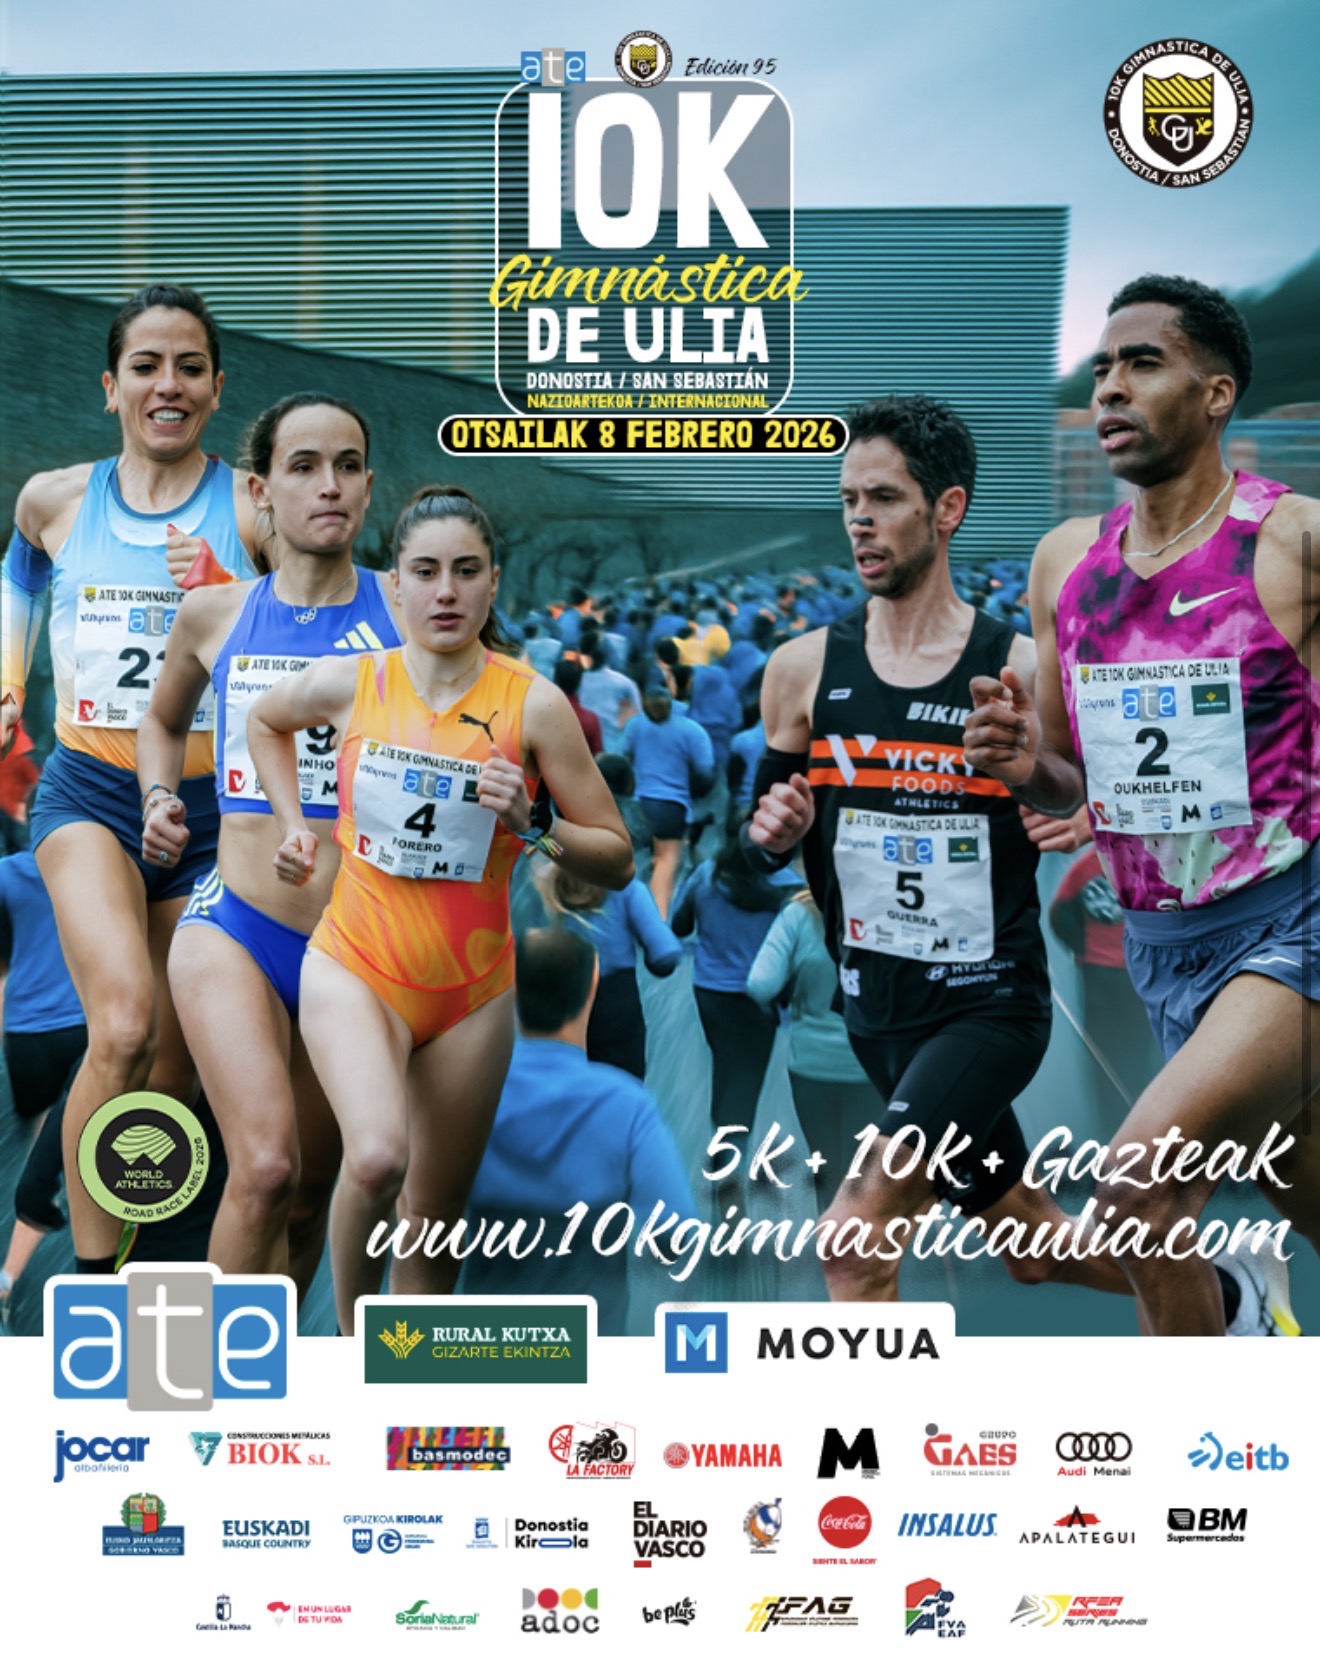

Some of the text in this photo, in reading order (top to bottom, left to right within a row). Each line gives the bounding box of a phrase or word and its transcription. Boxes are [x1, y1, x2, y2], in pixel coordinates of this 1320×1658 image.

[522, 51, 584, 83] ate
[685, 57, 777, 76] Edición 95
[1108, 40, 1249, 105] 10K GIMNASTICA DE ULIA
[1109, 128, 1158, 183] DONOSTIA
[1172, 172, 1201, 186] SAN
[1202, 119, 1251, 179] SEBASTIAN
[528, 92, 776, 250] 10K
[489, 253, 810, 312] Gimnástica
[528, 307, 770, 363] DE ULIA
[526, 372, 613, 389] DONOSTIA
[632, 372, 667, 389] SAN
[674, 366, 769, 389] SEBASTIÁN
[527, 393, 633, 408] NAZIOARTEKOA
[649, 393, 769, 408] INTERNACIONAL
[451, 420, 836, 448] OTSAILAK 8 FEBRERO 2026
[99, 589, 117, 601] ATE
[118, 589, 134, 601] 10K
[116, 647, 165, 689] 2
[252, 659, 269, 671] ATE
[272, 659, 287, 672] 10K
[1092, 662, 1230, 682] ATE 10K GIMNASTICA DE ULIA
[1124, 687, 1175, 719] ate
[379, 746, 478, 775] ATE 10K GIMNASTICA DE
[1135, 727, 1171, 777] 2
[884, 749, 975, 778] VICKY
[404, 771, 450, 798] ate
[892, 776, 965, 796] FOODS
[1114, 780, 1202, 795] OUKHELFEN
[894, 798, 960, 809] ATHLETICS
[404, 803, 436, 839] 4
[856, 814, 980, 831] ATE 10K GIMNASTICA DE ULIA
[392, 836, 442, 853] FORERO
[884, 837, 932, 866] ate
[896, 871, 925, 911] 5
[887, 910, 938, 927] GUERRA
[1022, 1120, 1295, 1191] Gazteak
[115, 1180, 172, 1189] ATHLETICS
[123, 1136, 205, 1218] ROAD RACE LABEL 2026
[124, 1170, 164, 1179] WORLD
[60, 1284, 280, 1399] ate
[432, 1327, 571, 1342] RURAL KUTXA
[757, 1326, 940, 1360] MOYUA
[432, 1346, 571, 1358] GIZARTE EKINTZA
[227, 1431, 331, 1440] CONSTRUCCIONES METÁLICAS
[979, 1431, 1017, 1439] GRUPO
[54, 1430, 150, 1483] jocar
[227, 1442, 302, 1465] BIOK
[412, 1448, 508, 1462] basmodec
[691, 1444, 782, 1467] YAMAHA
[924, 1433, 1017, 1466] GAES
[1226, 1443, 1290, 1471] eitb
[566, 1464, 635, 1476] LA FACTORY
[1057, 1466, 1132, 1476] Audi Menai
[343, 1514, 444, 1524] GIPUZKOA KIROLAK
[633, 1501, 658, 1518] EL
[1199, 1508, 1248, 1531] BM
[222, 1520, 310, 1536] EUSKADI
[515, 1518, 589, 1532] Donostia
[633, 1520, 708, 1538] DIARIO
[898, 1513, 997, 1537] INSALUS
[222, 1539, 311, 1549] BASQUE COUNTRY
[1019, 1532, 1135, 1544] APALATEGUI
[1167, 1533, 1245, 1543] Supermercados
[633, 1540, 706, 1558] VASCO
[298, 1605, 352, 1613] EN UN LUGAR
[642, 1601, 696, 1624] be plus
[298, 1616, 343, 1624] DE TU VIDA
[521, 1610, 600, 1634] adoc
[938, 1620, 967, 1629] FVA
[938, 1630, 967, 1638] EAF
